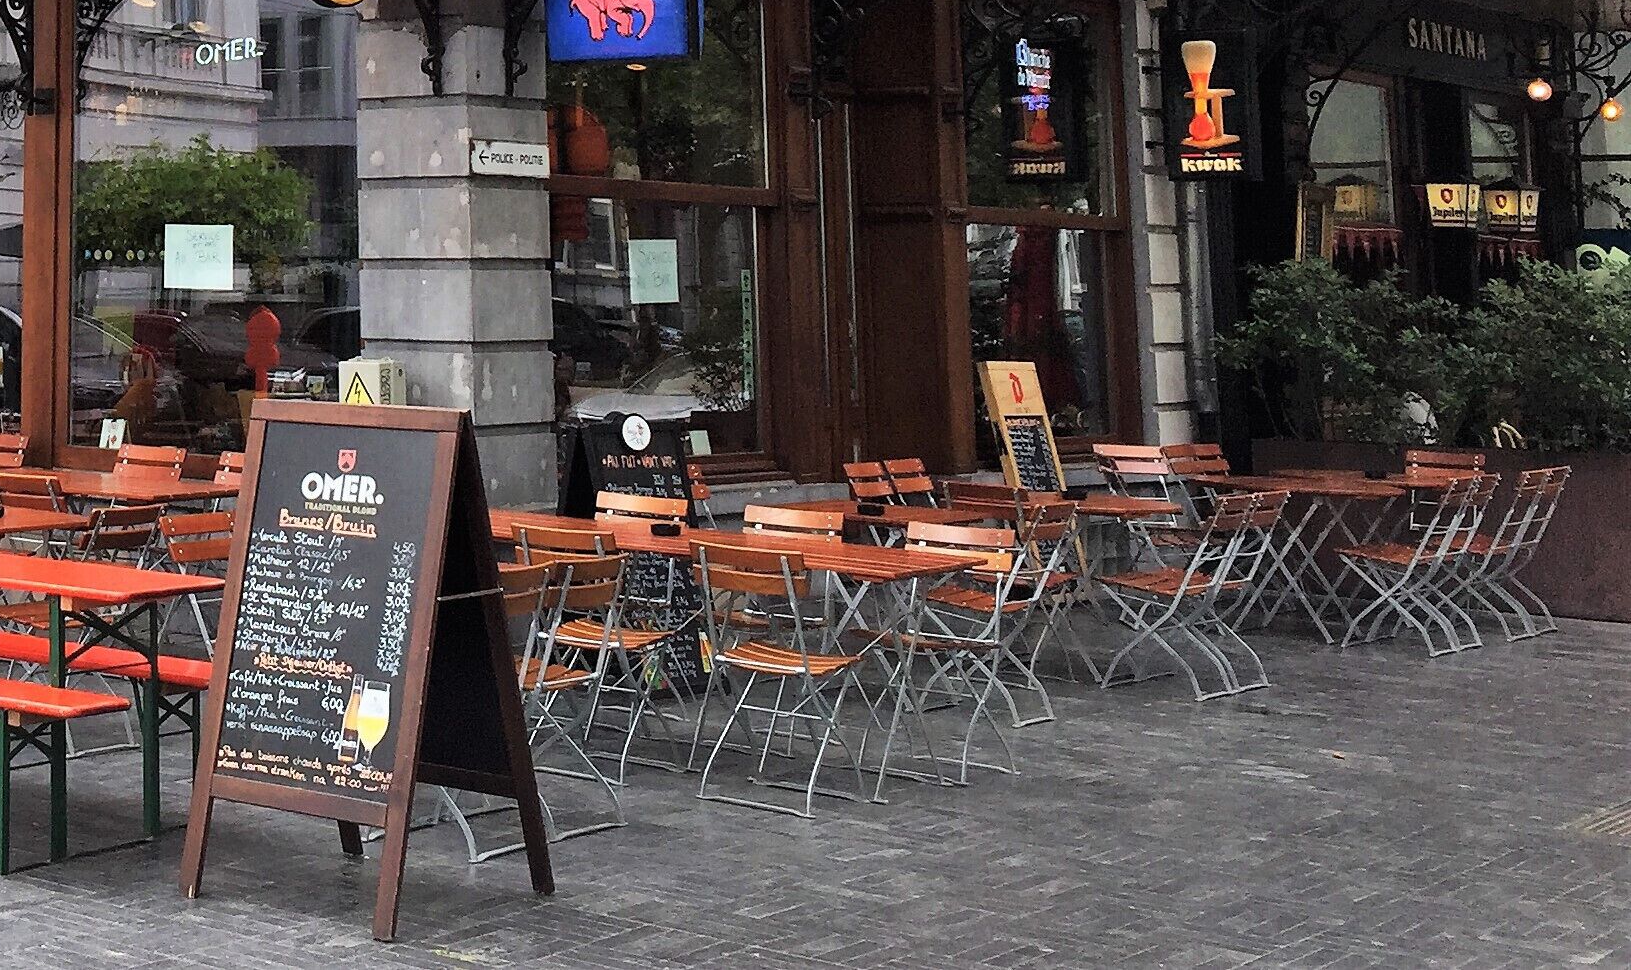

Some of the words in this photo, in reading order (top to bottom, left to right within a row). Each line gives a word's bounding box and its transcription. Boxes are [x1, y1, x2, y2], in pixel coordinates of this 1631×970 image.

[1408, 17, 1487, 61] SANTANA
[491, 153, 514, 164] POLICE
[301, 472, 385, 505] OMER.
